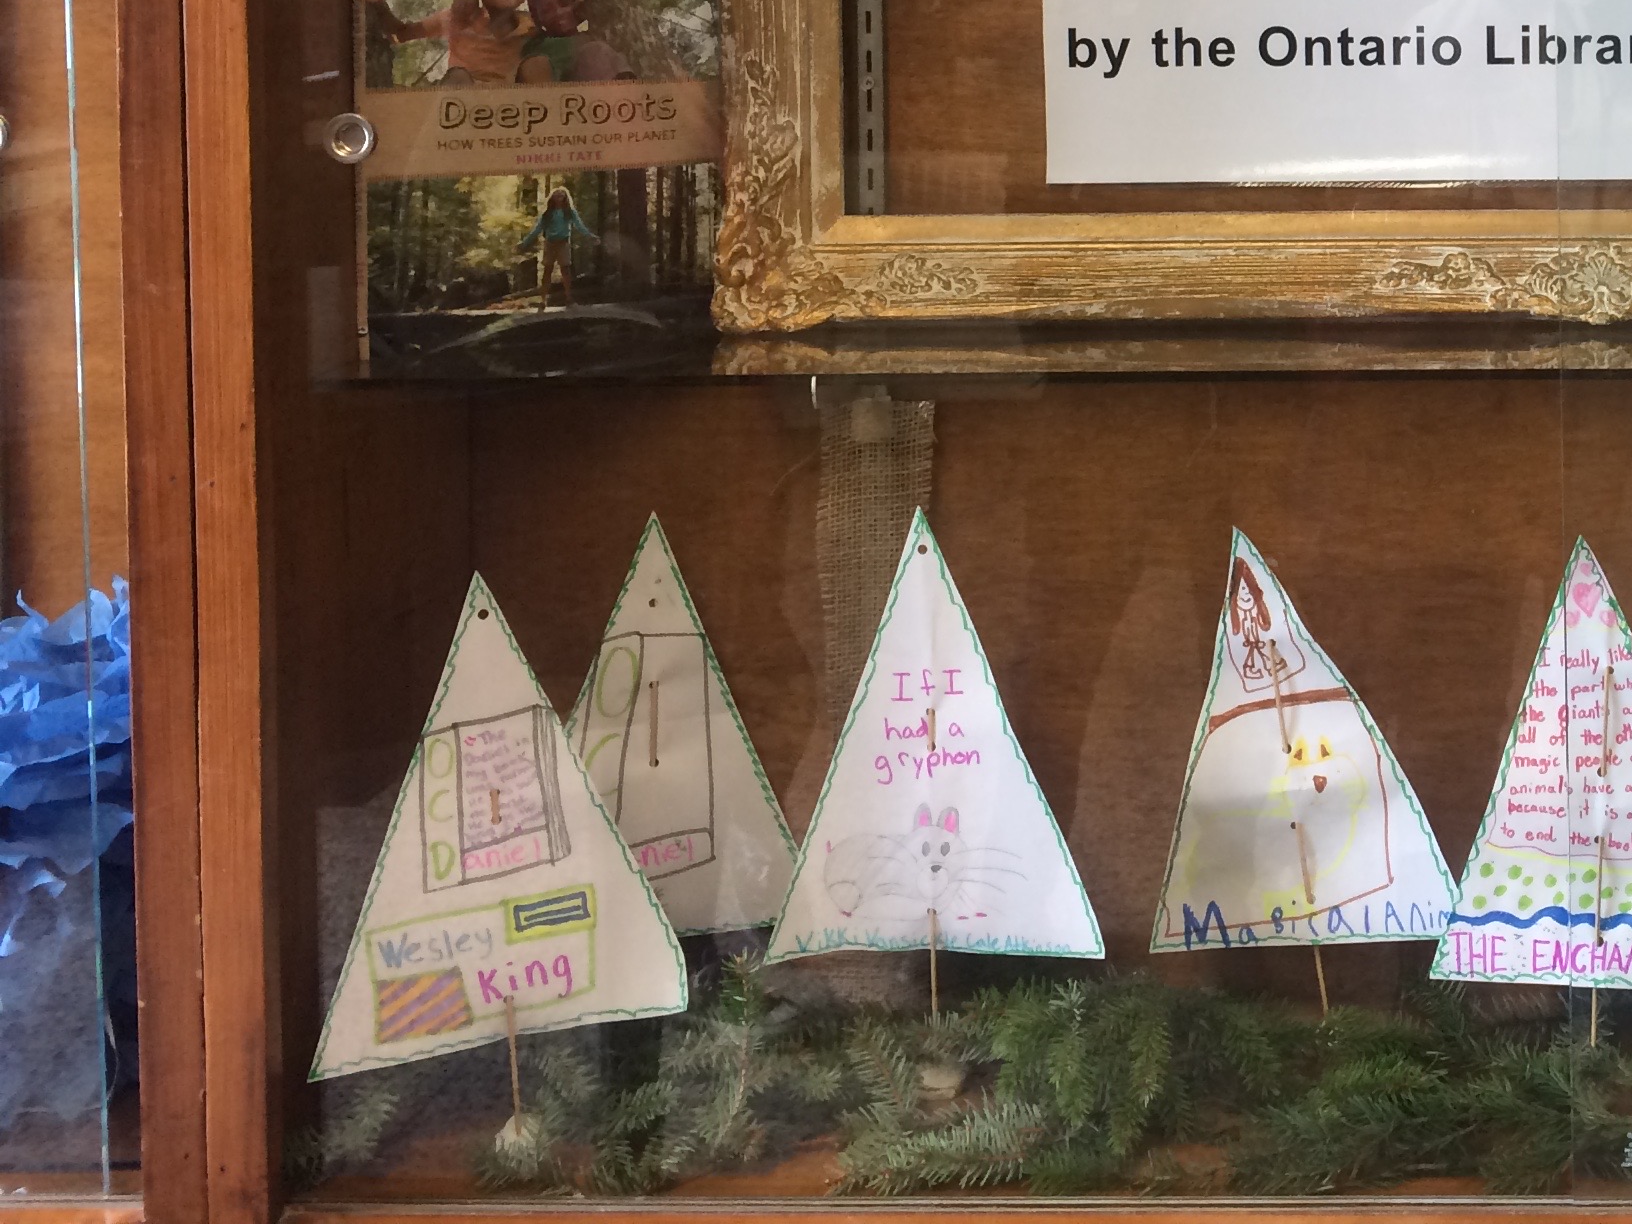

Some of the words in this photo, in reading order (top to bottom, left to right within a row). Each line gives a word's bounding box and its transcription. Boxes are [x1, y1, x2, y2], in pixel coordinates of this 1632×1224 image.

[1066, 28, 1131, 78] by
[1151, 26, 1237, 68] the
[1257, 26, 1463, 69] Ontario
[439, 96, 549, 135] Deep
[560, 93, 678, 126] Roots
[437, 139, 473, 151] HOW
[480, 137, 523, 149] TREES
[528, 134, 588, 148] SUSTAIN
[592, 132, 622, 145] OUR
[628, 129, 677, 142] PLANET
[884, 717, 930, 741] had
[949, 722, 965, 737] a
[874, 747, 982, 785] gryphon
[1513, 754, 1561, 774] magic
[378, 927, 494, 969] Wesley
[1448, 931, 1507, 974] THE
[477, 954, 574, 1005] King
